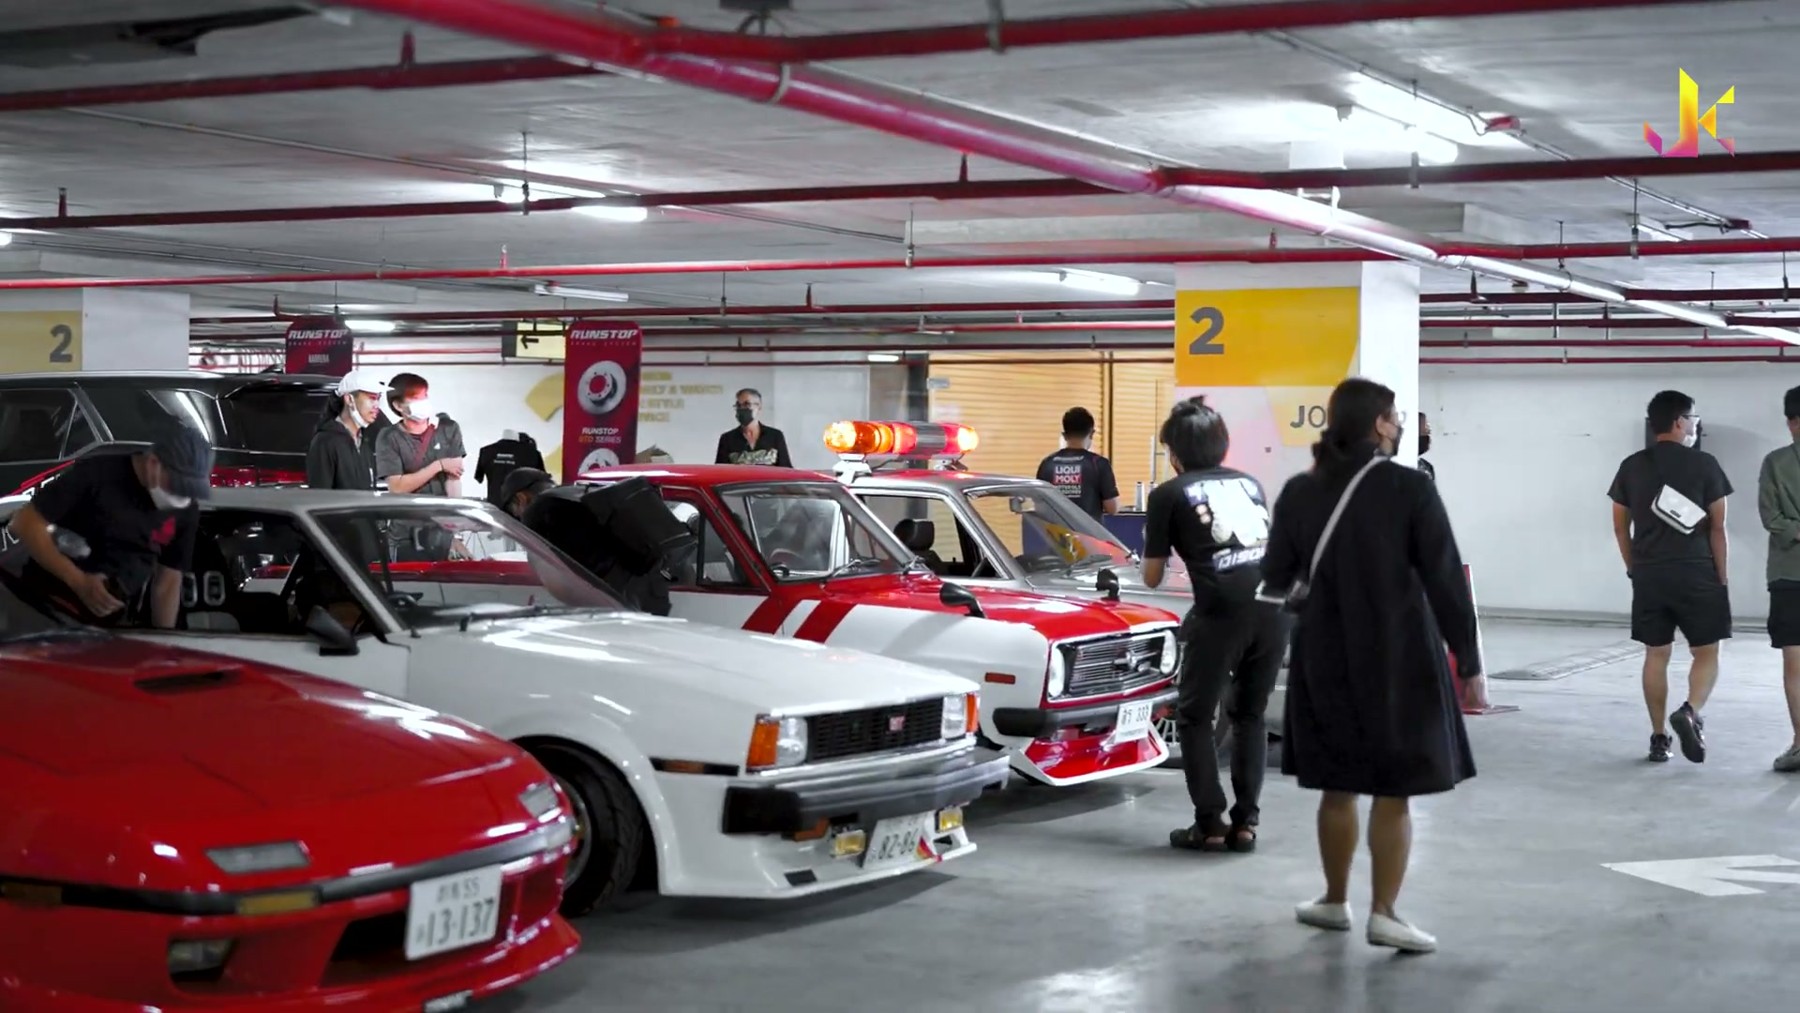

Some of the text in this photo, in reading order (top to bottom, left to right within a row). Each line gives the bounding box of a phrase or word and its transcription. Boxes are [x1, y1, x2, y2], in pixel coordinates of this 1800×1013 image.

[288, 329, 349, 339] RUNSTOP
[570, 329, 639, 339] RUNSTOP
[1189, 306, 1224, 355] 2
[50, 324, 73, 362] 2
[1290, 405, 1327, 428] JO
[1055, 465, 1081, 474] LIQUI
[1055, 474, 1081, 484] MOLY
